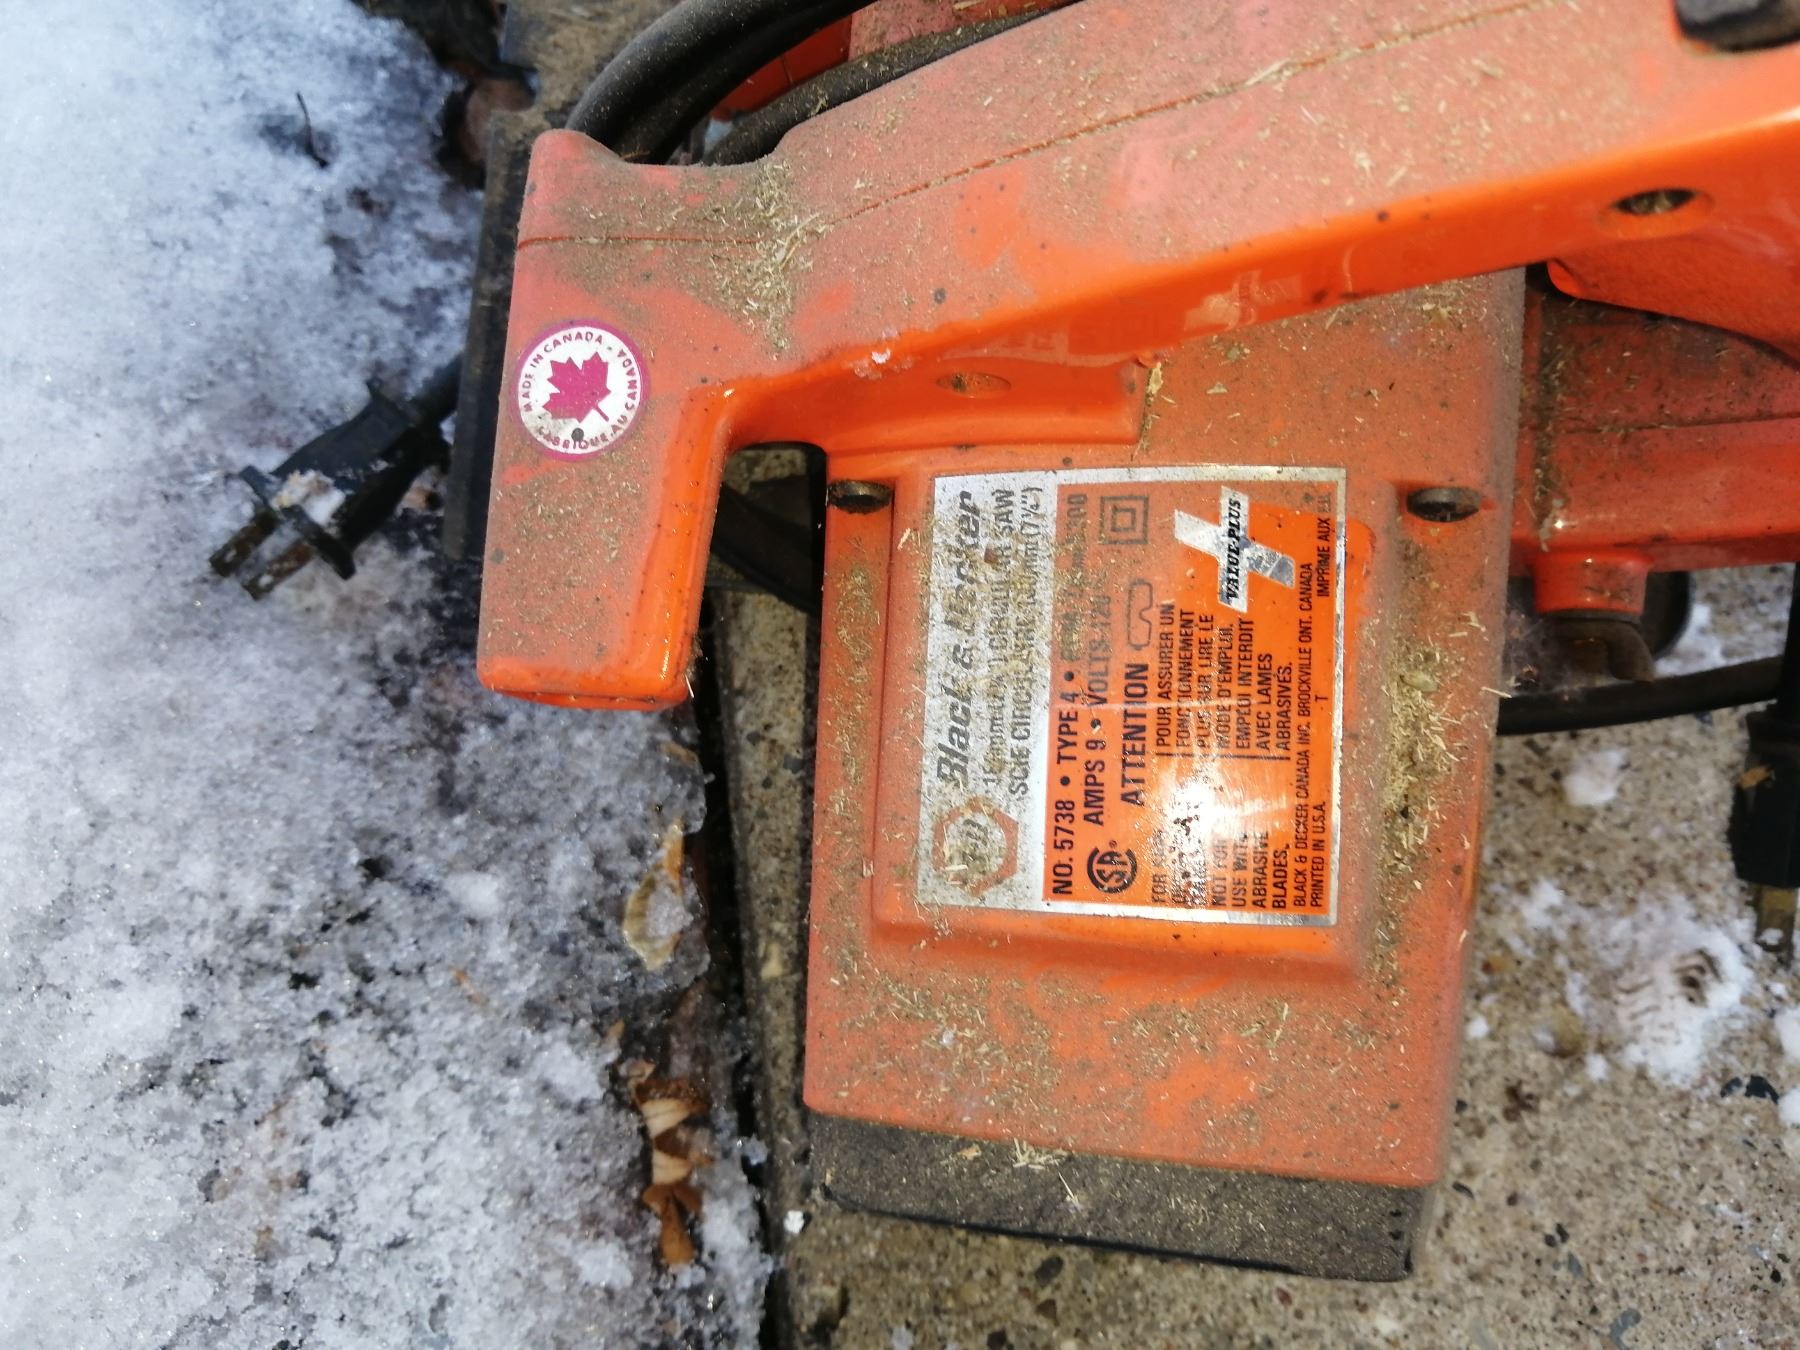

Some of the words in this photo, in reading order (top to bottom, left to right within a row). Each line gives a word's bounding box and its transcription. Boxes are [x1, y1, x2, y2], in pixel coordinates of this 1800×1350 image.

[522, 373, 534, 413] MADE
[530, 354, 544, 368] IN
[543, 331, 603, 353] CANADA
[616, 349, 638, 411] CANADA
[610, 415, 628, 436] AU
[1317, 517, 1330, 542] AUX
[1299, 562, 1312, 612] CANADA
[1317, 546, 1330, 598] IMPRIME
[1160, 604, 1175, 625] UN
[1199, 614, 1214, 631] LE
[1298, 616, 1312, 643] ONT.
[1087, 639, 1110, 707] VOLTS
[1157, 632, 1173, 700] ASSURER
[1198, 638, 1213, 668] LIRE
[1238, 618, 1254, 686] INTERDIT
[1060, 692, 1079, 703] 4
[1257, 653, 1272, 704] LAMES
[1297, 647, 1312, 717] BROCKVILLE
[936, 676, 972, 787] Black
[1056, 710, 1078, 764] TYPE
[1120, 663, 1149, 807] ATTENTION
[1156, 706, 1171, 747] POUR
[1196, 711, 1211, 749] PLUS
[1216, 705, 1231, 749] MODE
[1236, 693, 1251, 749] EMPLOI
[1256, 712, 1271, 750] AVEC
[1297, 722, 1311, 745] INC.
[1086, 739, 1106, 750] 9
[1008, 744, 1030, 795] SCIE
[1295, 752, 1309, 798] CANADA
[1083, 760, 1105, 826] AMPS
[1054, 800, 1075, 850] 5738
[1295, 804, 1308, 850] DECKER
[1312, 839, 1325, 851] IN
[1052, 858, 1073, 895] NO.
[1252, 832, 1268, 909] ABRASIVE
[1294, 855, 1307, 864] &
[1310, 857, 1325, 907] PRINTED
[1152, 874, 1166, 903] FOR
[1212, 875, 1227, 906] NOT
[1231, 878, 1247, 907] USE
[1294, 869, 1307, 907] BLACK
